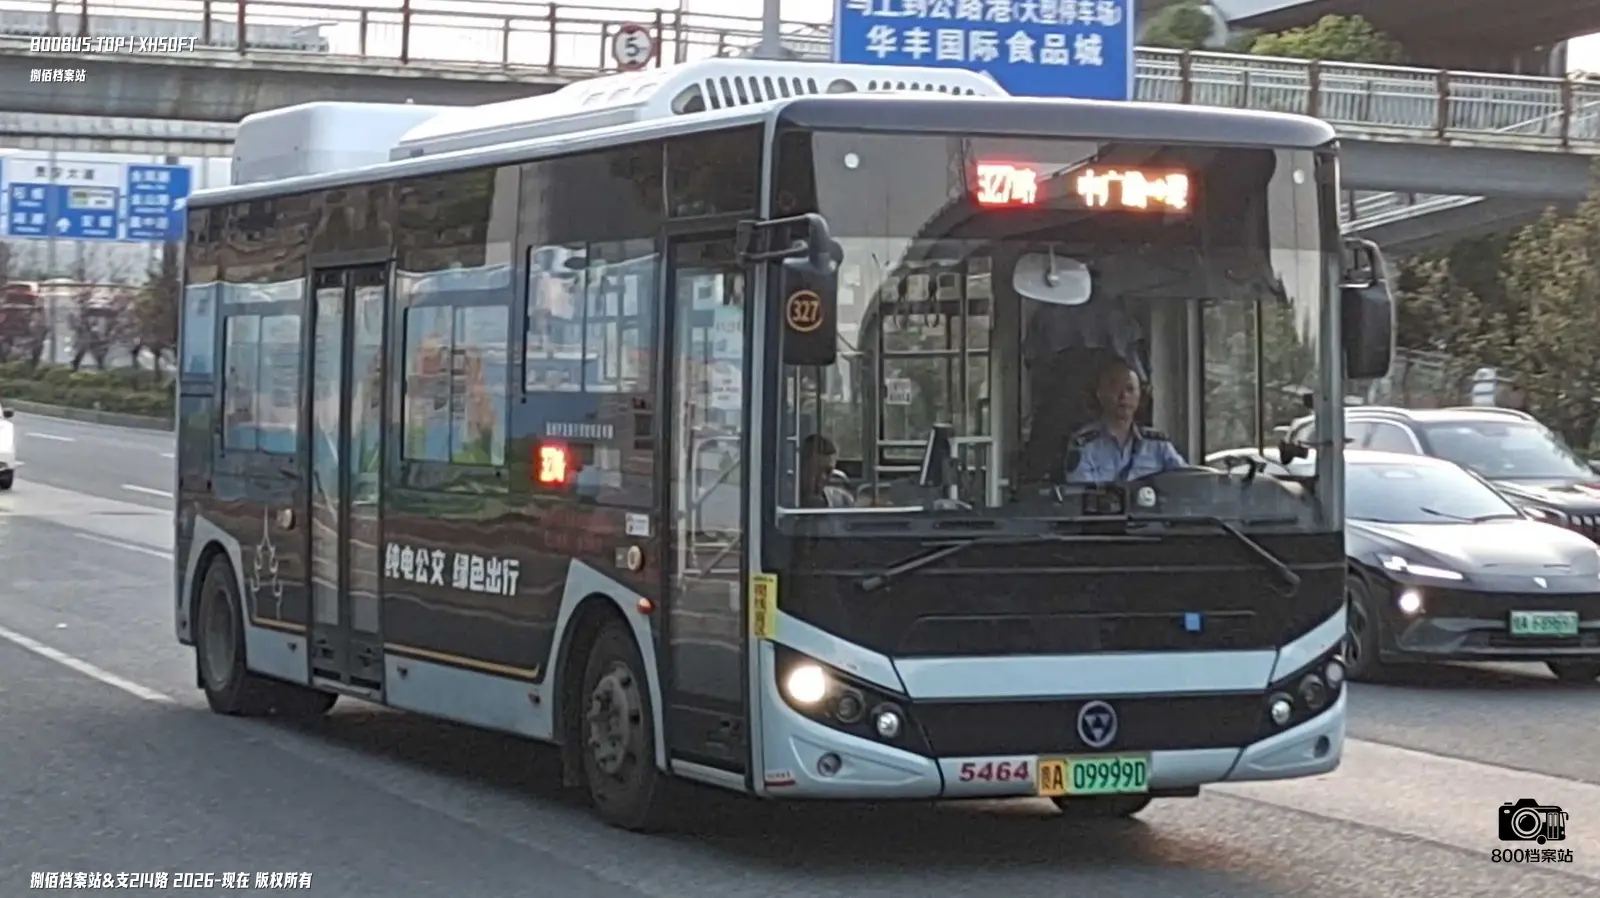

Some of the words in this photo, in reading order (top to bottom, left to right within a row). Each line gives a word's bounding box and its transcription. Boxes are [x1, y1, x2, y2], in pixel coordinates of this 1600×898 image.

[865, 24, 1105, 66] 华丰国际食品城
[791, 300, 821, 323] 327
[384, 542, 446, 587] 纯电公交
[452, 552, 520, 597] 绿色出行
[959, 761, 1030, 782] 5464
